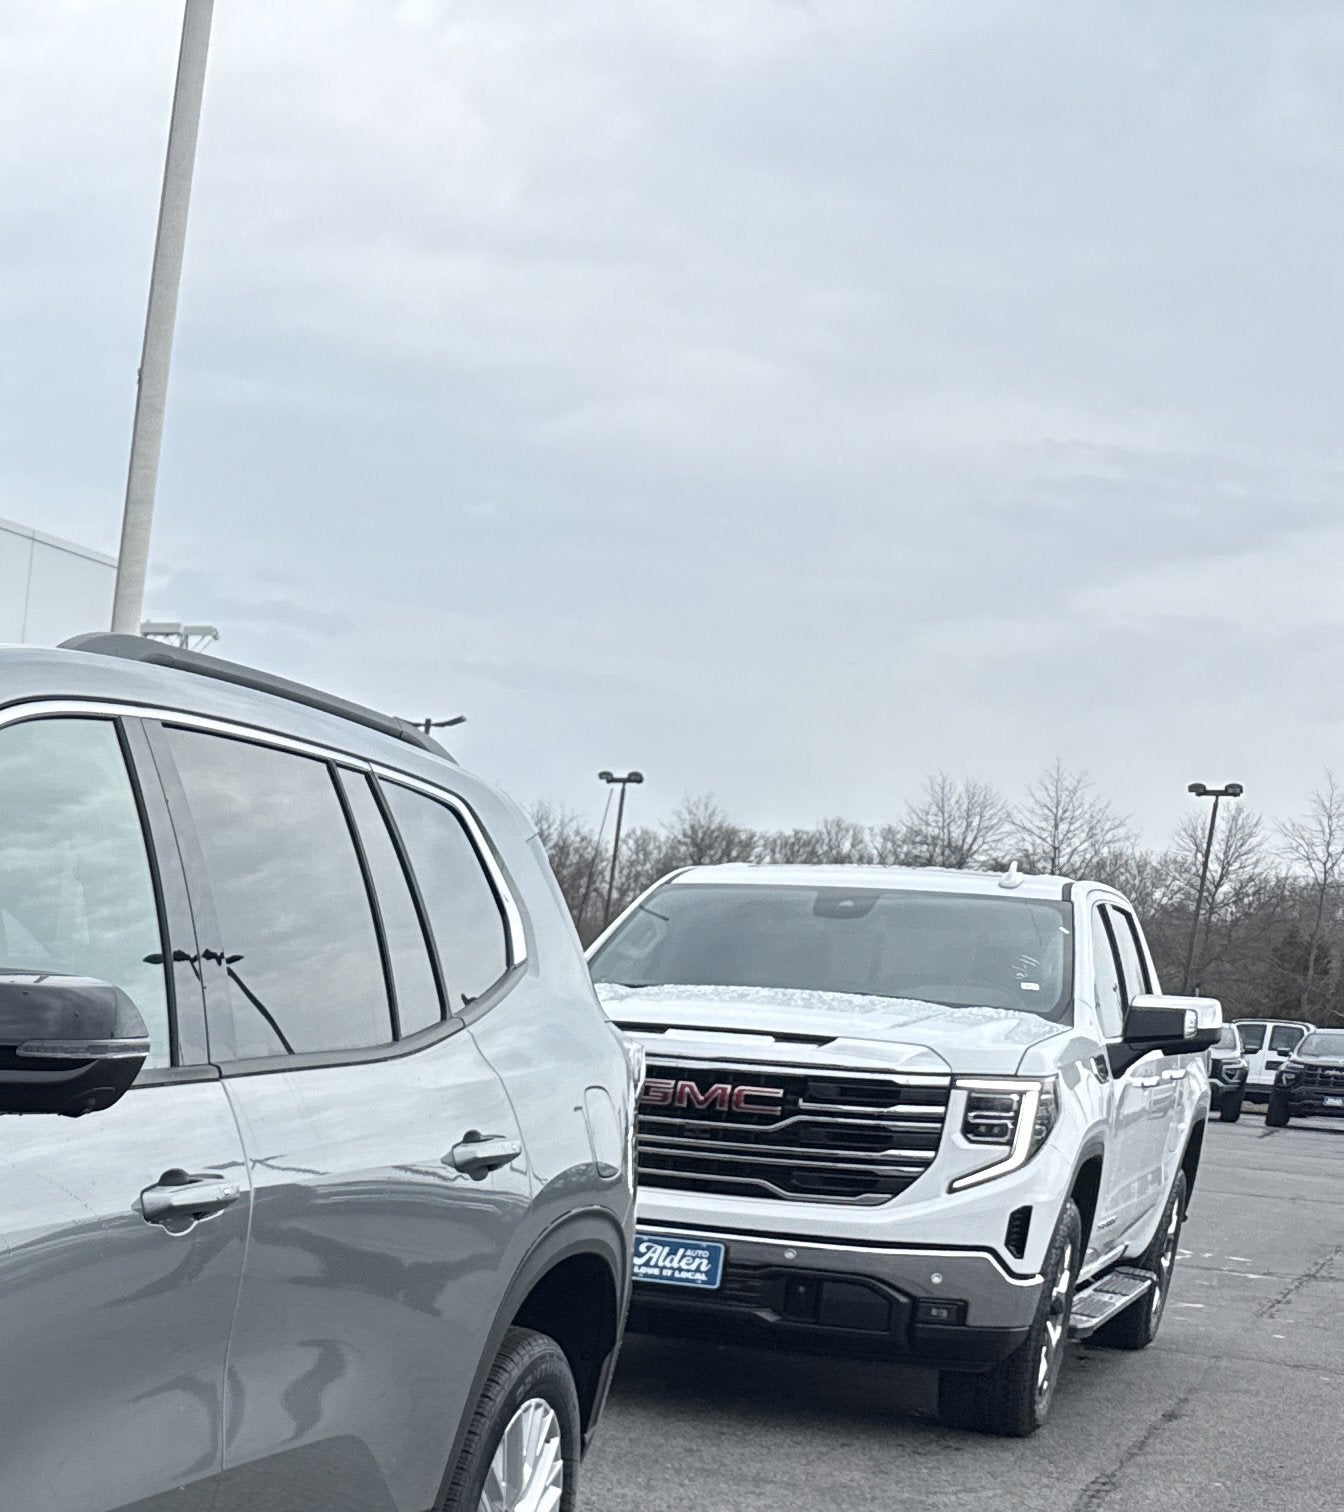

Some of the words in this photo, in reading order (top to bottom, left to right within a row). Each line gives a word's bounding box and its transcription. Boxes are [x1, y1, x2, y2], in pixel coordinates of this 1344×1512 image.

[639, 1078, 784, 1116] GMC
[633, 1242, 711, 1271] Alden
[685, 1248, 710, 1258] AUTO
[633, 1265, 660, 1275] LOVE
[662, 1268, 673, 1276] IT
[674, 1270, 708, 1280] LOCAL
